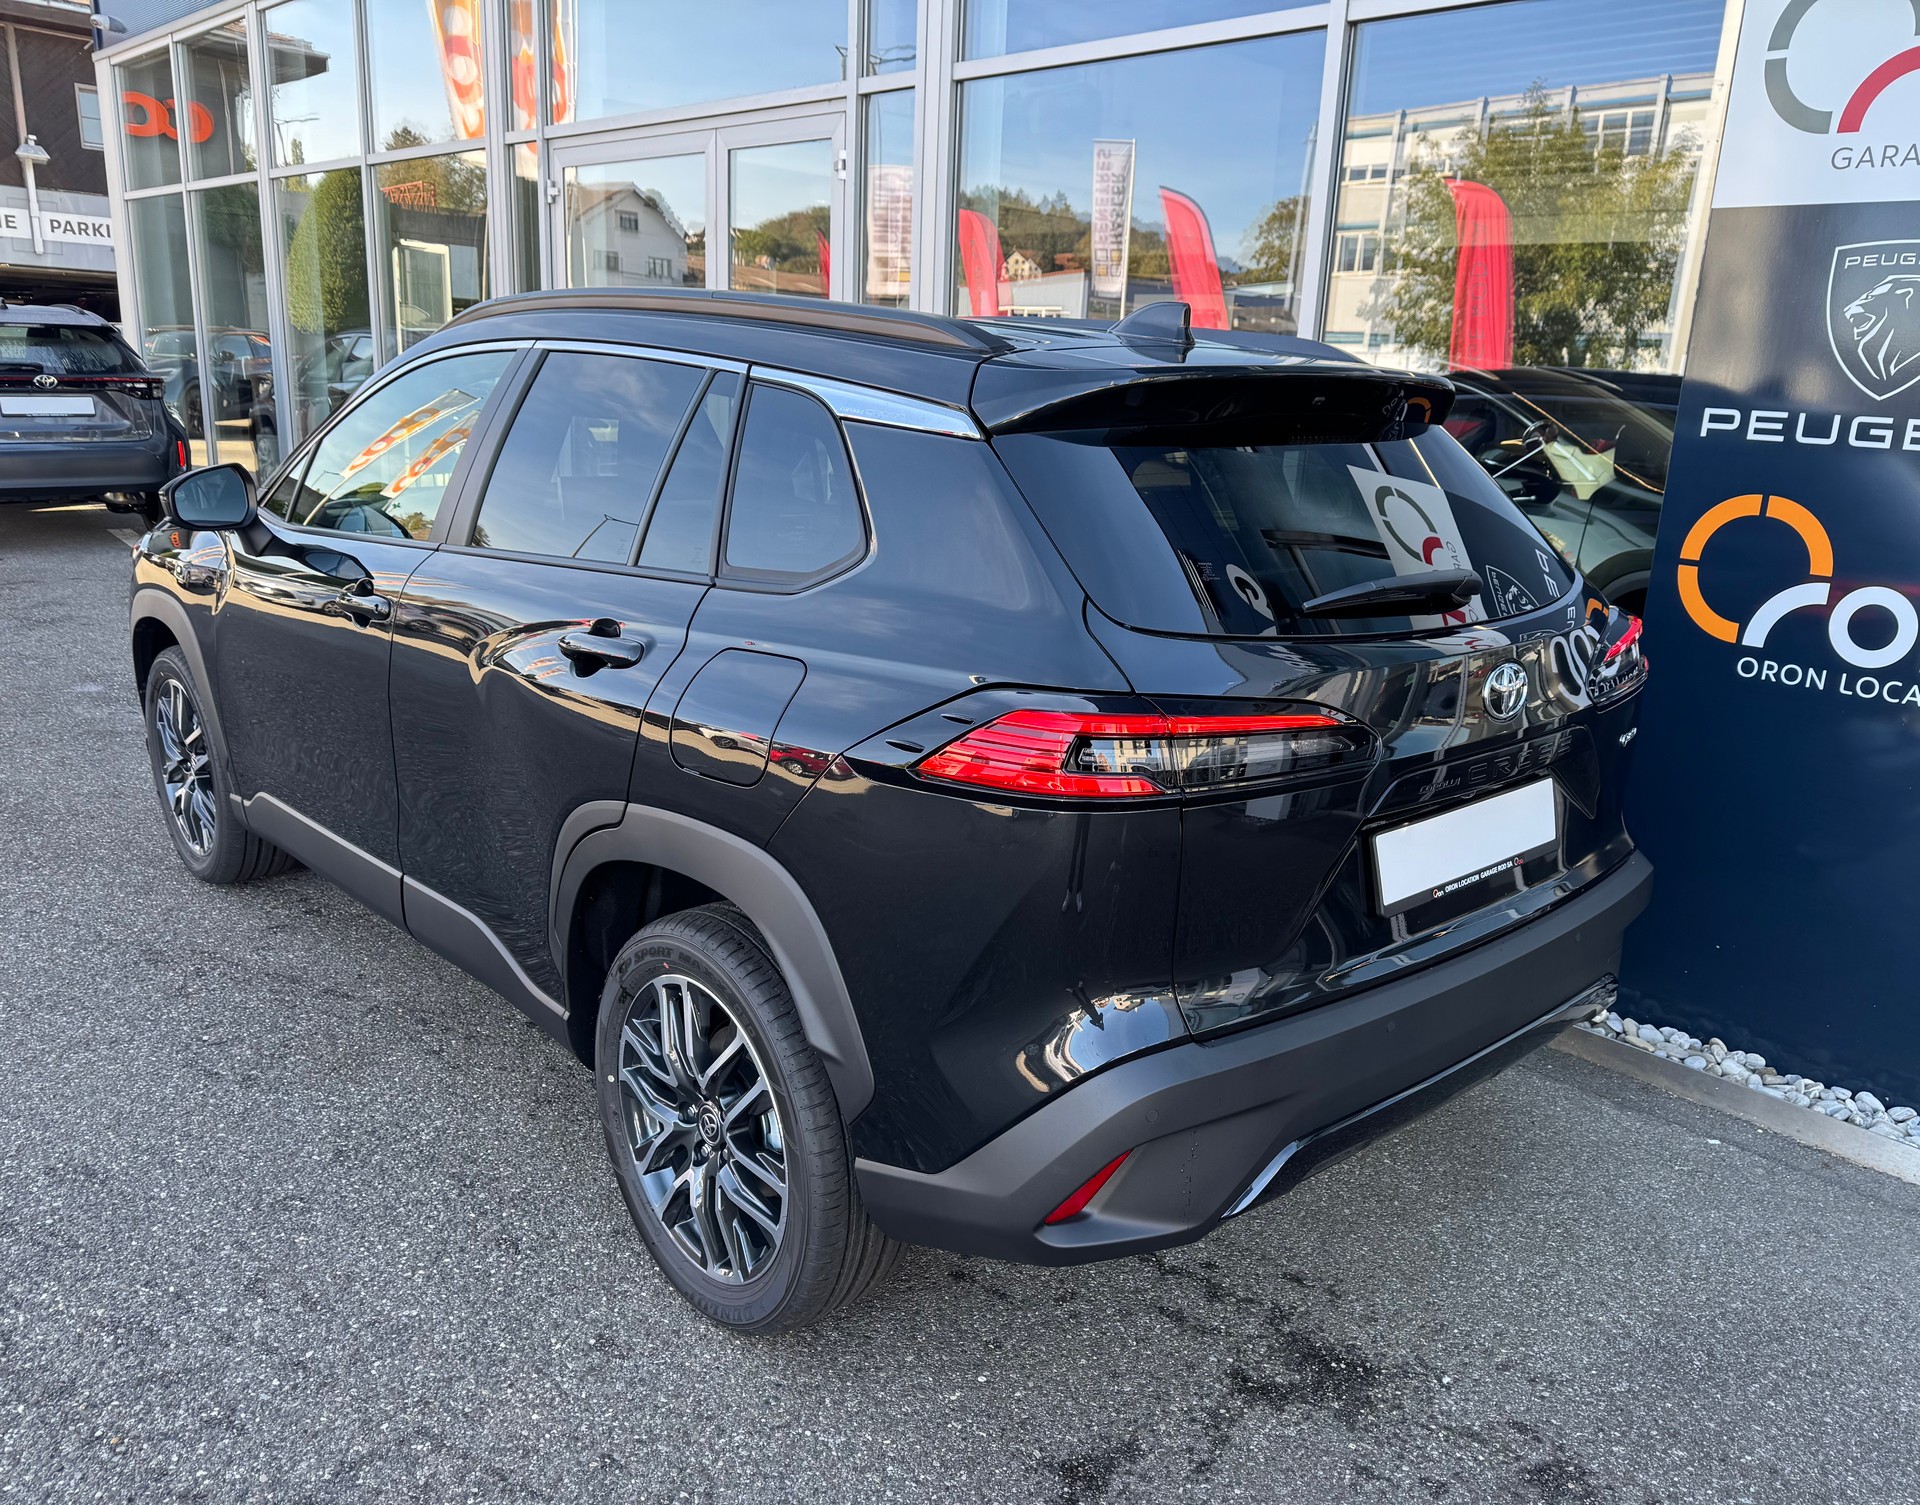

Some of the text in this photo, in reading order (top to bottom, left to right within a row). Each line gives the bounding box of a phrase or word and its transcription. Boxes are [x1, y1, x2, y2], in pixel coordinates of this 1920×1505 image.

[1831, 143, 1920, 170] GARA
[49, 218, 111, 239] PARKI
[1844, 252, 1920, 270] PEUG
[1737, 656, 1920, 707] ORON LOCA
[1445, 882, 1459, 893] ORON
[1458, 874, 1480, 888] LOCATION
[1480, 866, 1498, 879] GARAGE
[1506, 860, 1513, 868] SA
[633, 946, 674, 963] SPORT
